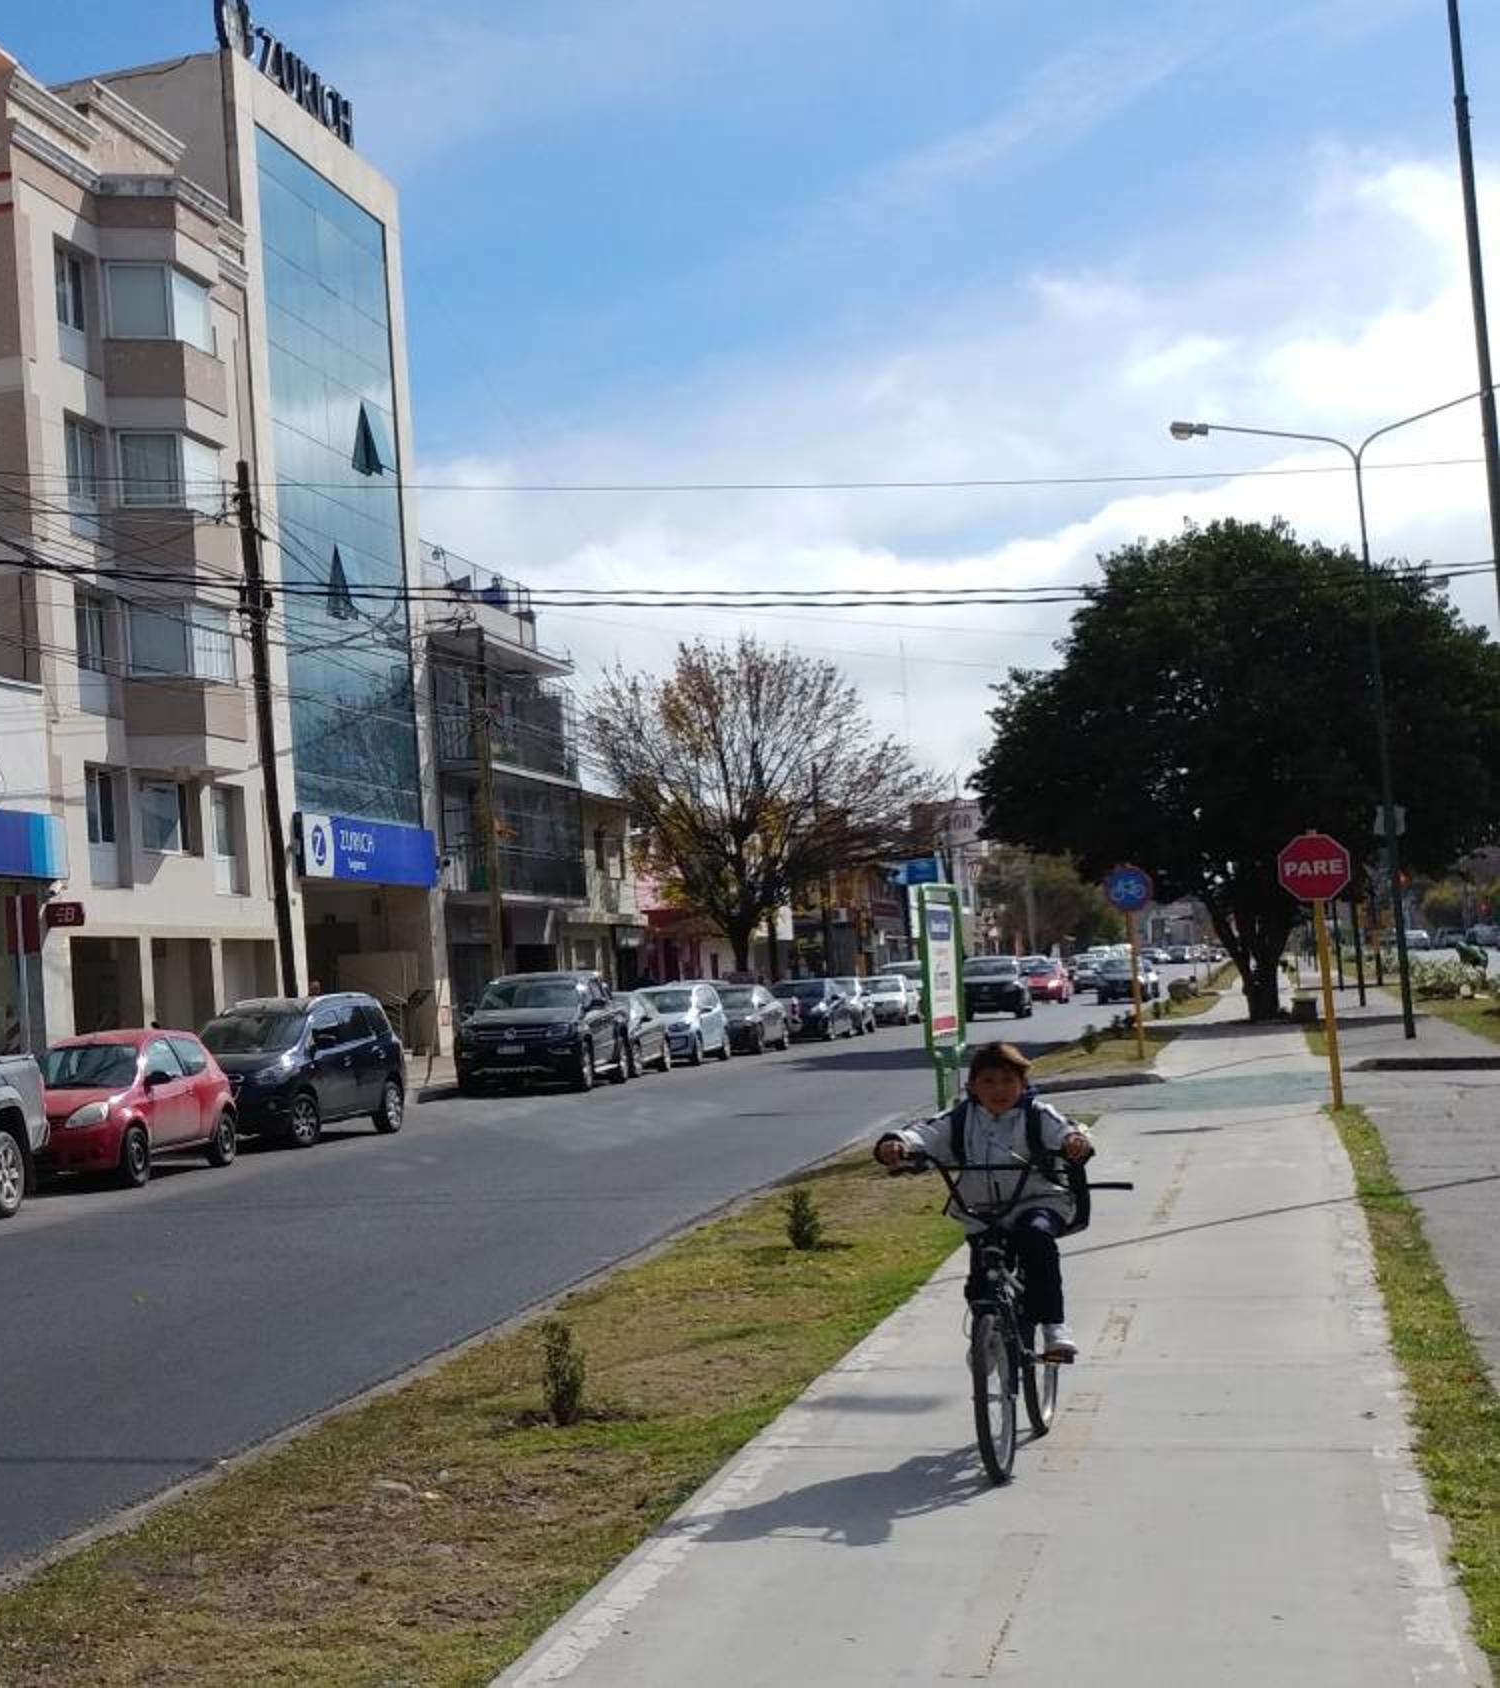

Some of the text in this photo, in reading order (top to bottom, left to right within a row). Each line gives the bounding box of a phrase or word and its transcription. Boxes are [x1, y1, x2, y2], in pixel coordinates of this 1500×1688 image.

[255, 27, 355, 149] ZURICH
[339, 829, 375, 855] ZURICH
[1284, 859, 1343, 876] PARE
